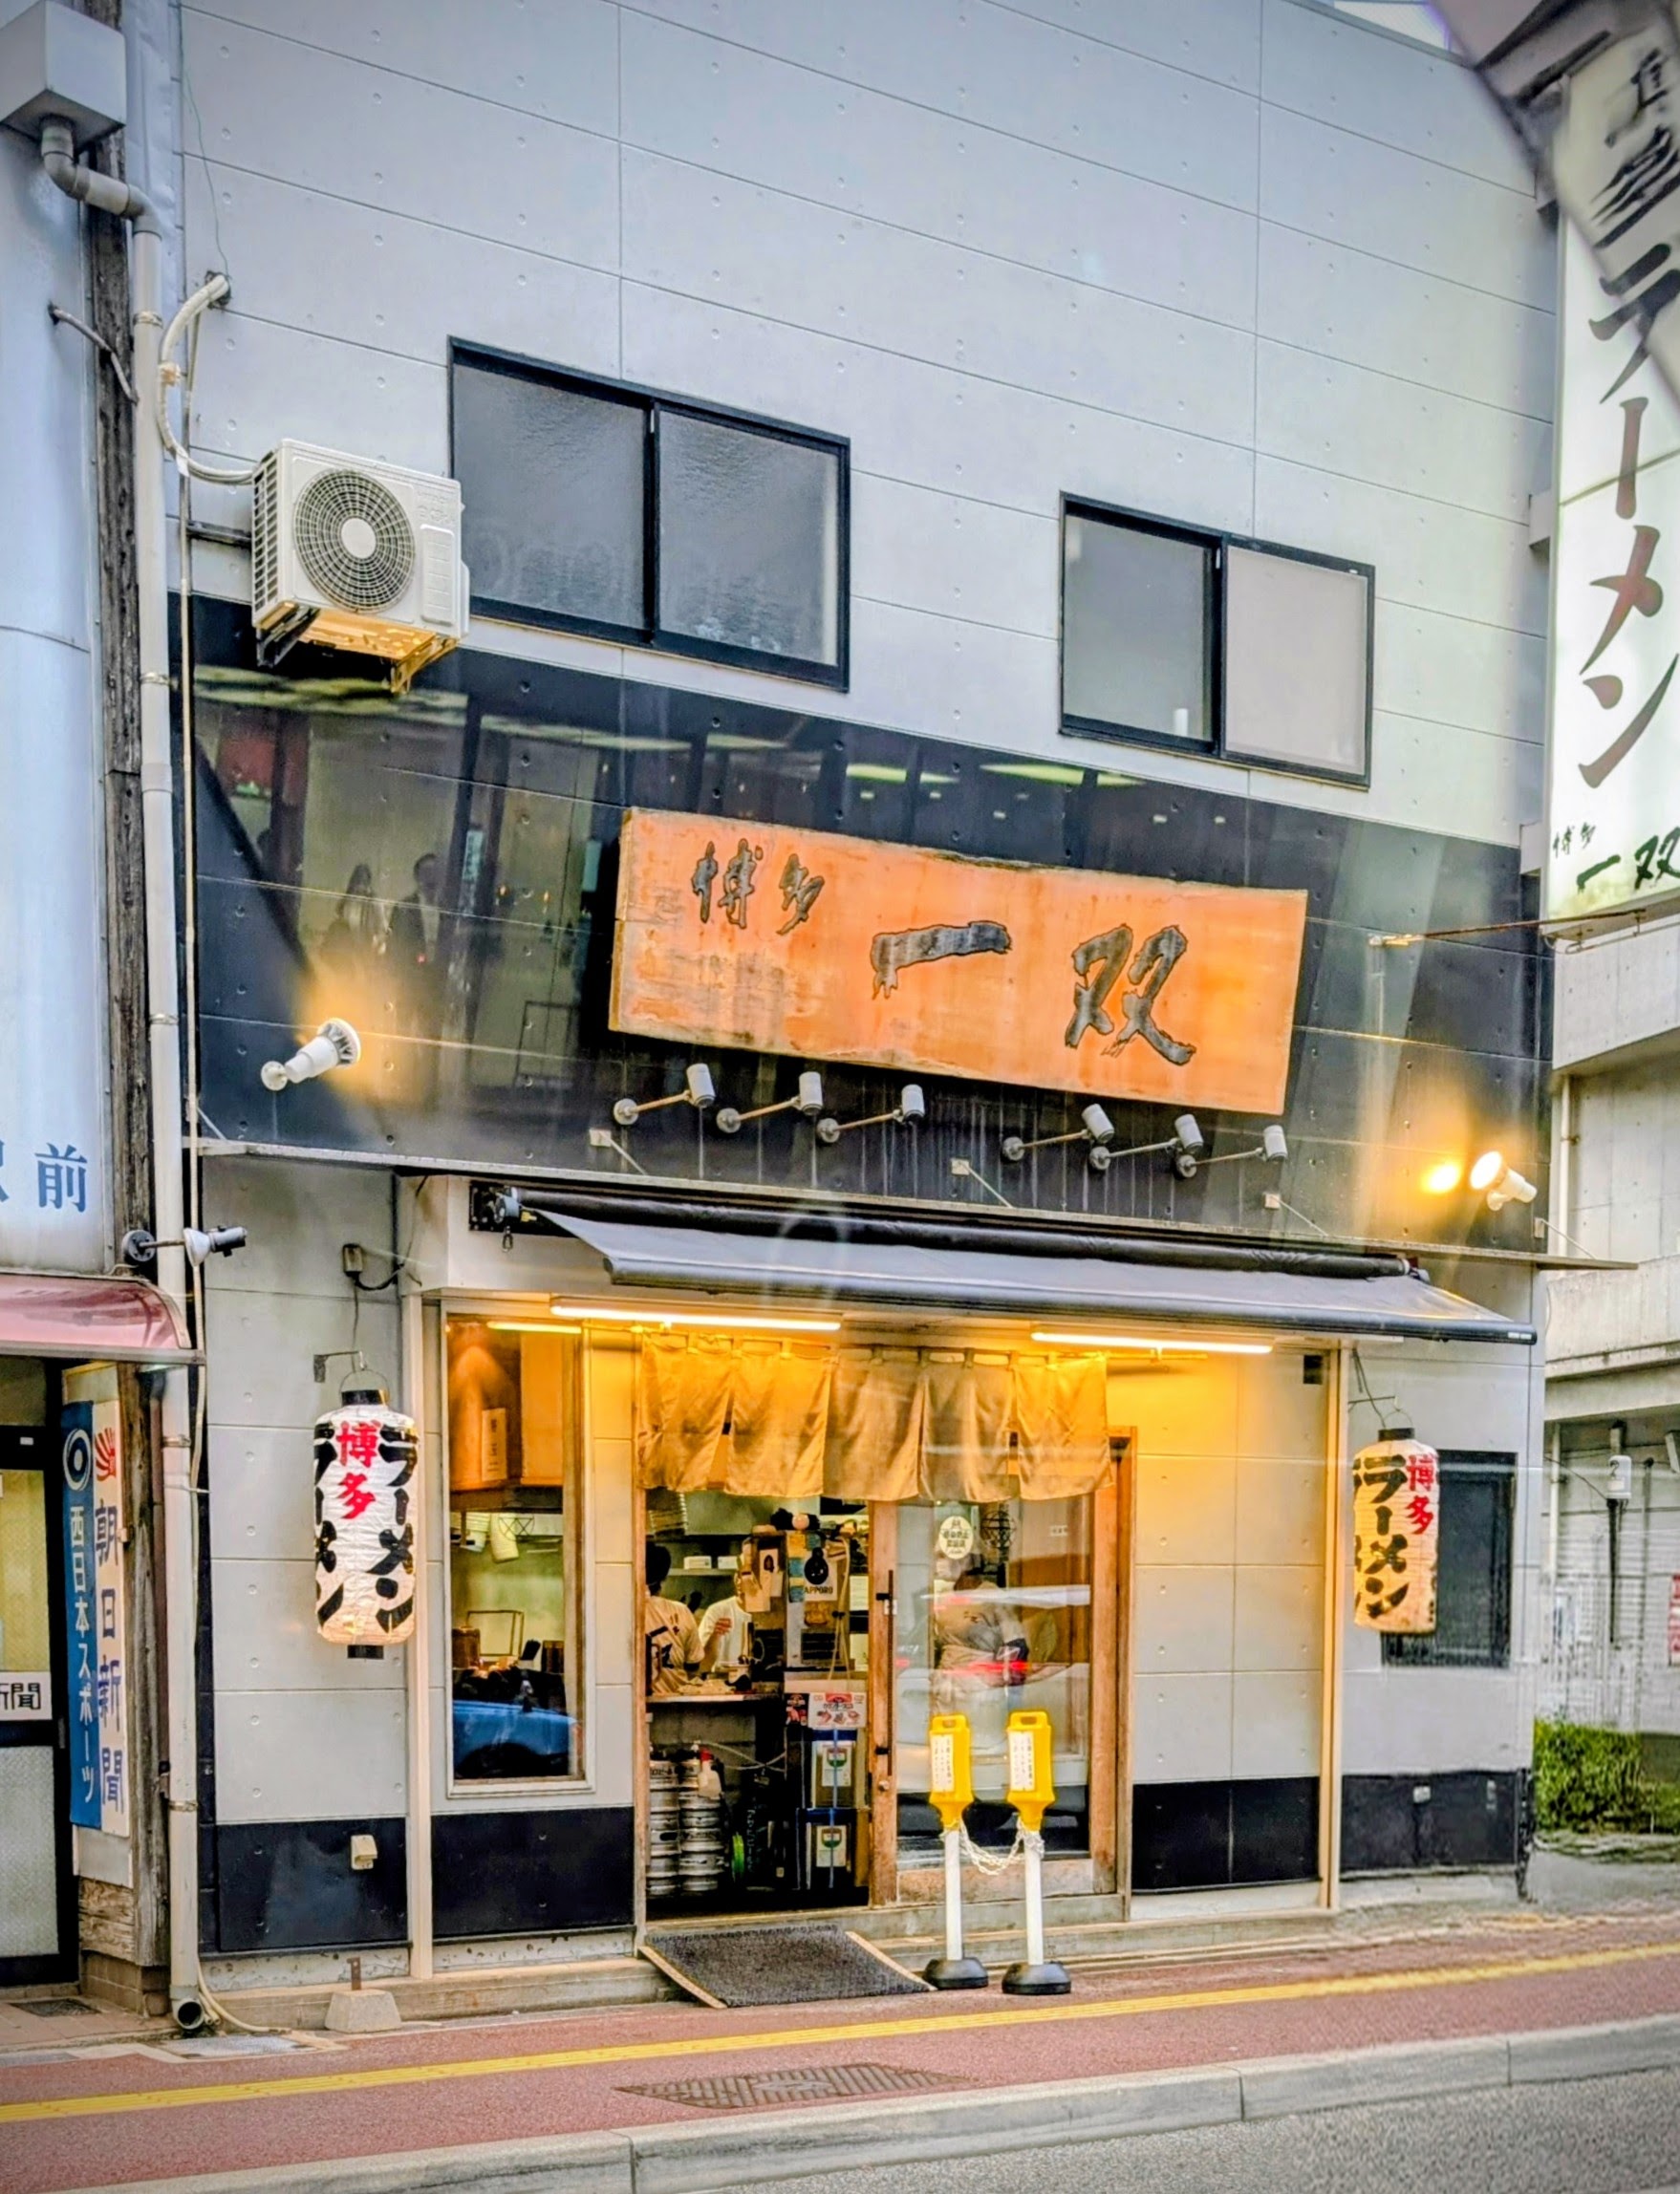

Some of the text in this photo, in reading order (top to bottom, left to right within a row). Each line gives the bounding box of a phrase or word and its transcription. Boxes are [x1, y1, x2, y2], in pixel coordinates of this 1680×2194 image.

[691, 838, 1197, 1066] 博多 一双
[0, 1140, 88, 1213] 前
[335, 1420, 377, 1519] 博多
[1363, 1453, 1408, 1619] ラーメン
[1406, 1454, 1434, 1535] 博多
[70, 1505, 95, 1803] 西日本スポーツ
[95, 1497, 124, 1815] 朝日新聞
